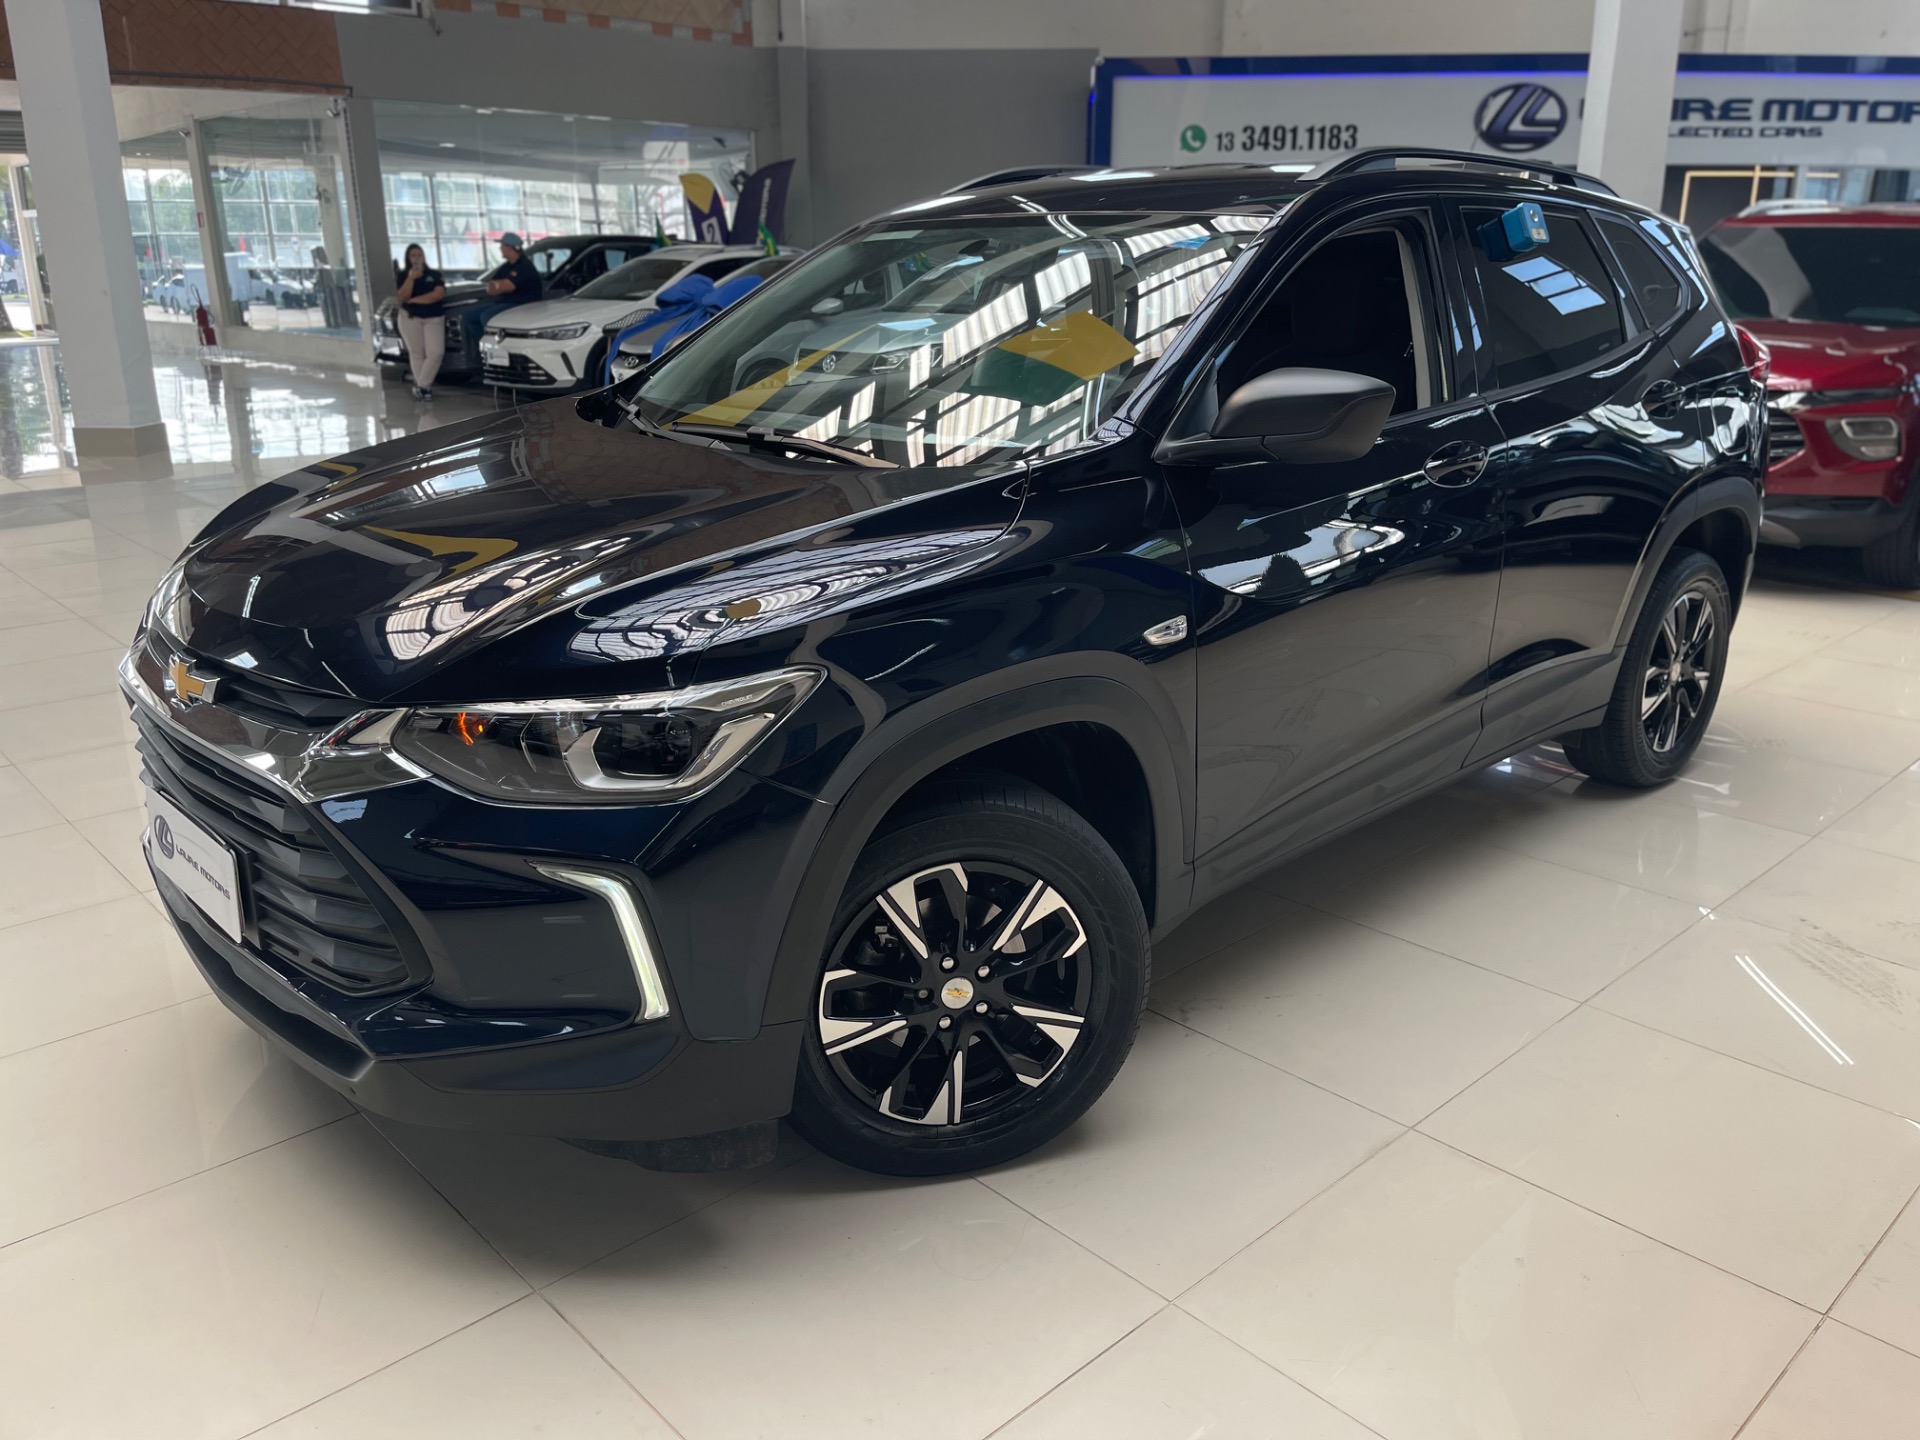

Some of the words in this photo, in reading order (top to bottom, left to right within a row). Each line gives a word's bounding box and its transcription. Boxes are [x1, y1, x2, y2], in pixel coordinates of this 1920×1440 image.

[1216, 132, 1234, 151] 13
[1241, 124, 1358, 151] 3491.1183
[1759, 127, 1823, 138] CARS
[175, 844, 199, 872] LAURE
[200, 866, 231, 900] MOTORS
